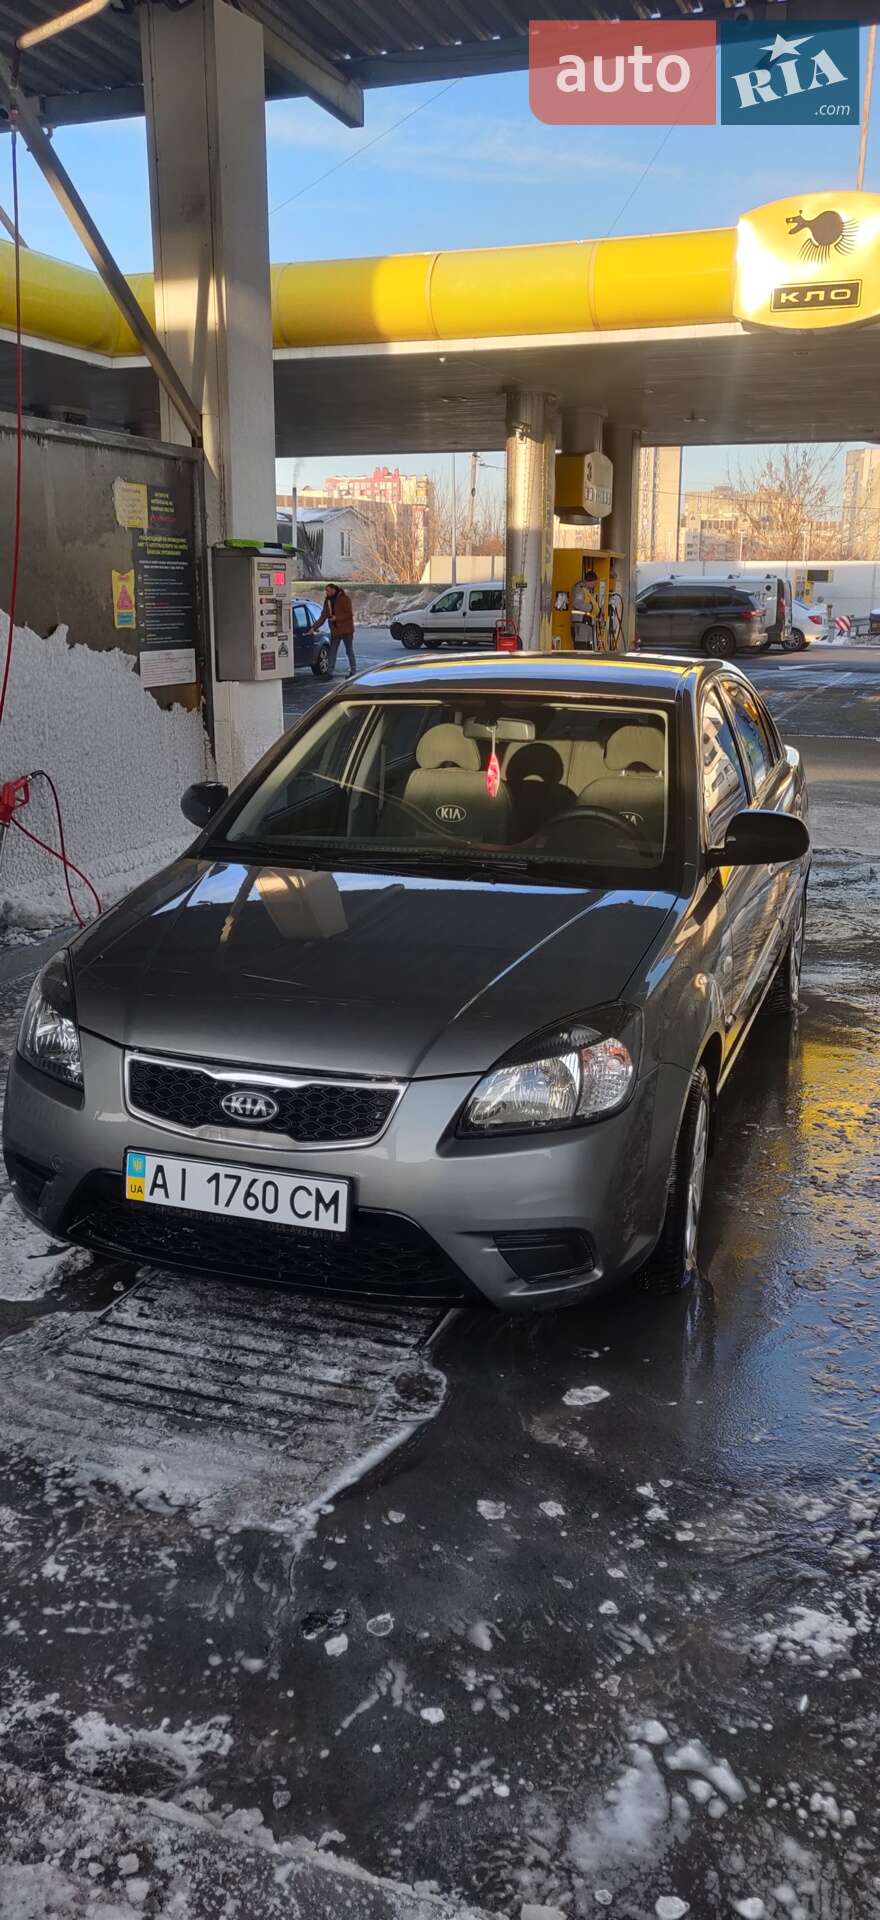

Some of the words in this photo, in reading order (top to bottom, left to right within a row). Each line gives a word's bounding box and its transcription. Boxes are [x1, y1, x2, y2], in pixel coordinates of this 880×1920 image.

[780, 289, 851, 303] КЛО
[440, 806, 462, 820] KIA
[230, 1096, 268, 1117] KIA
[130, 1185, 144, 1194] UA
[149, 1164, 187, 1202] AI
[206, 1172, 279, 1214] 1760
[289, 1185, 340, 1224] CM
